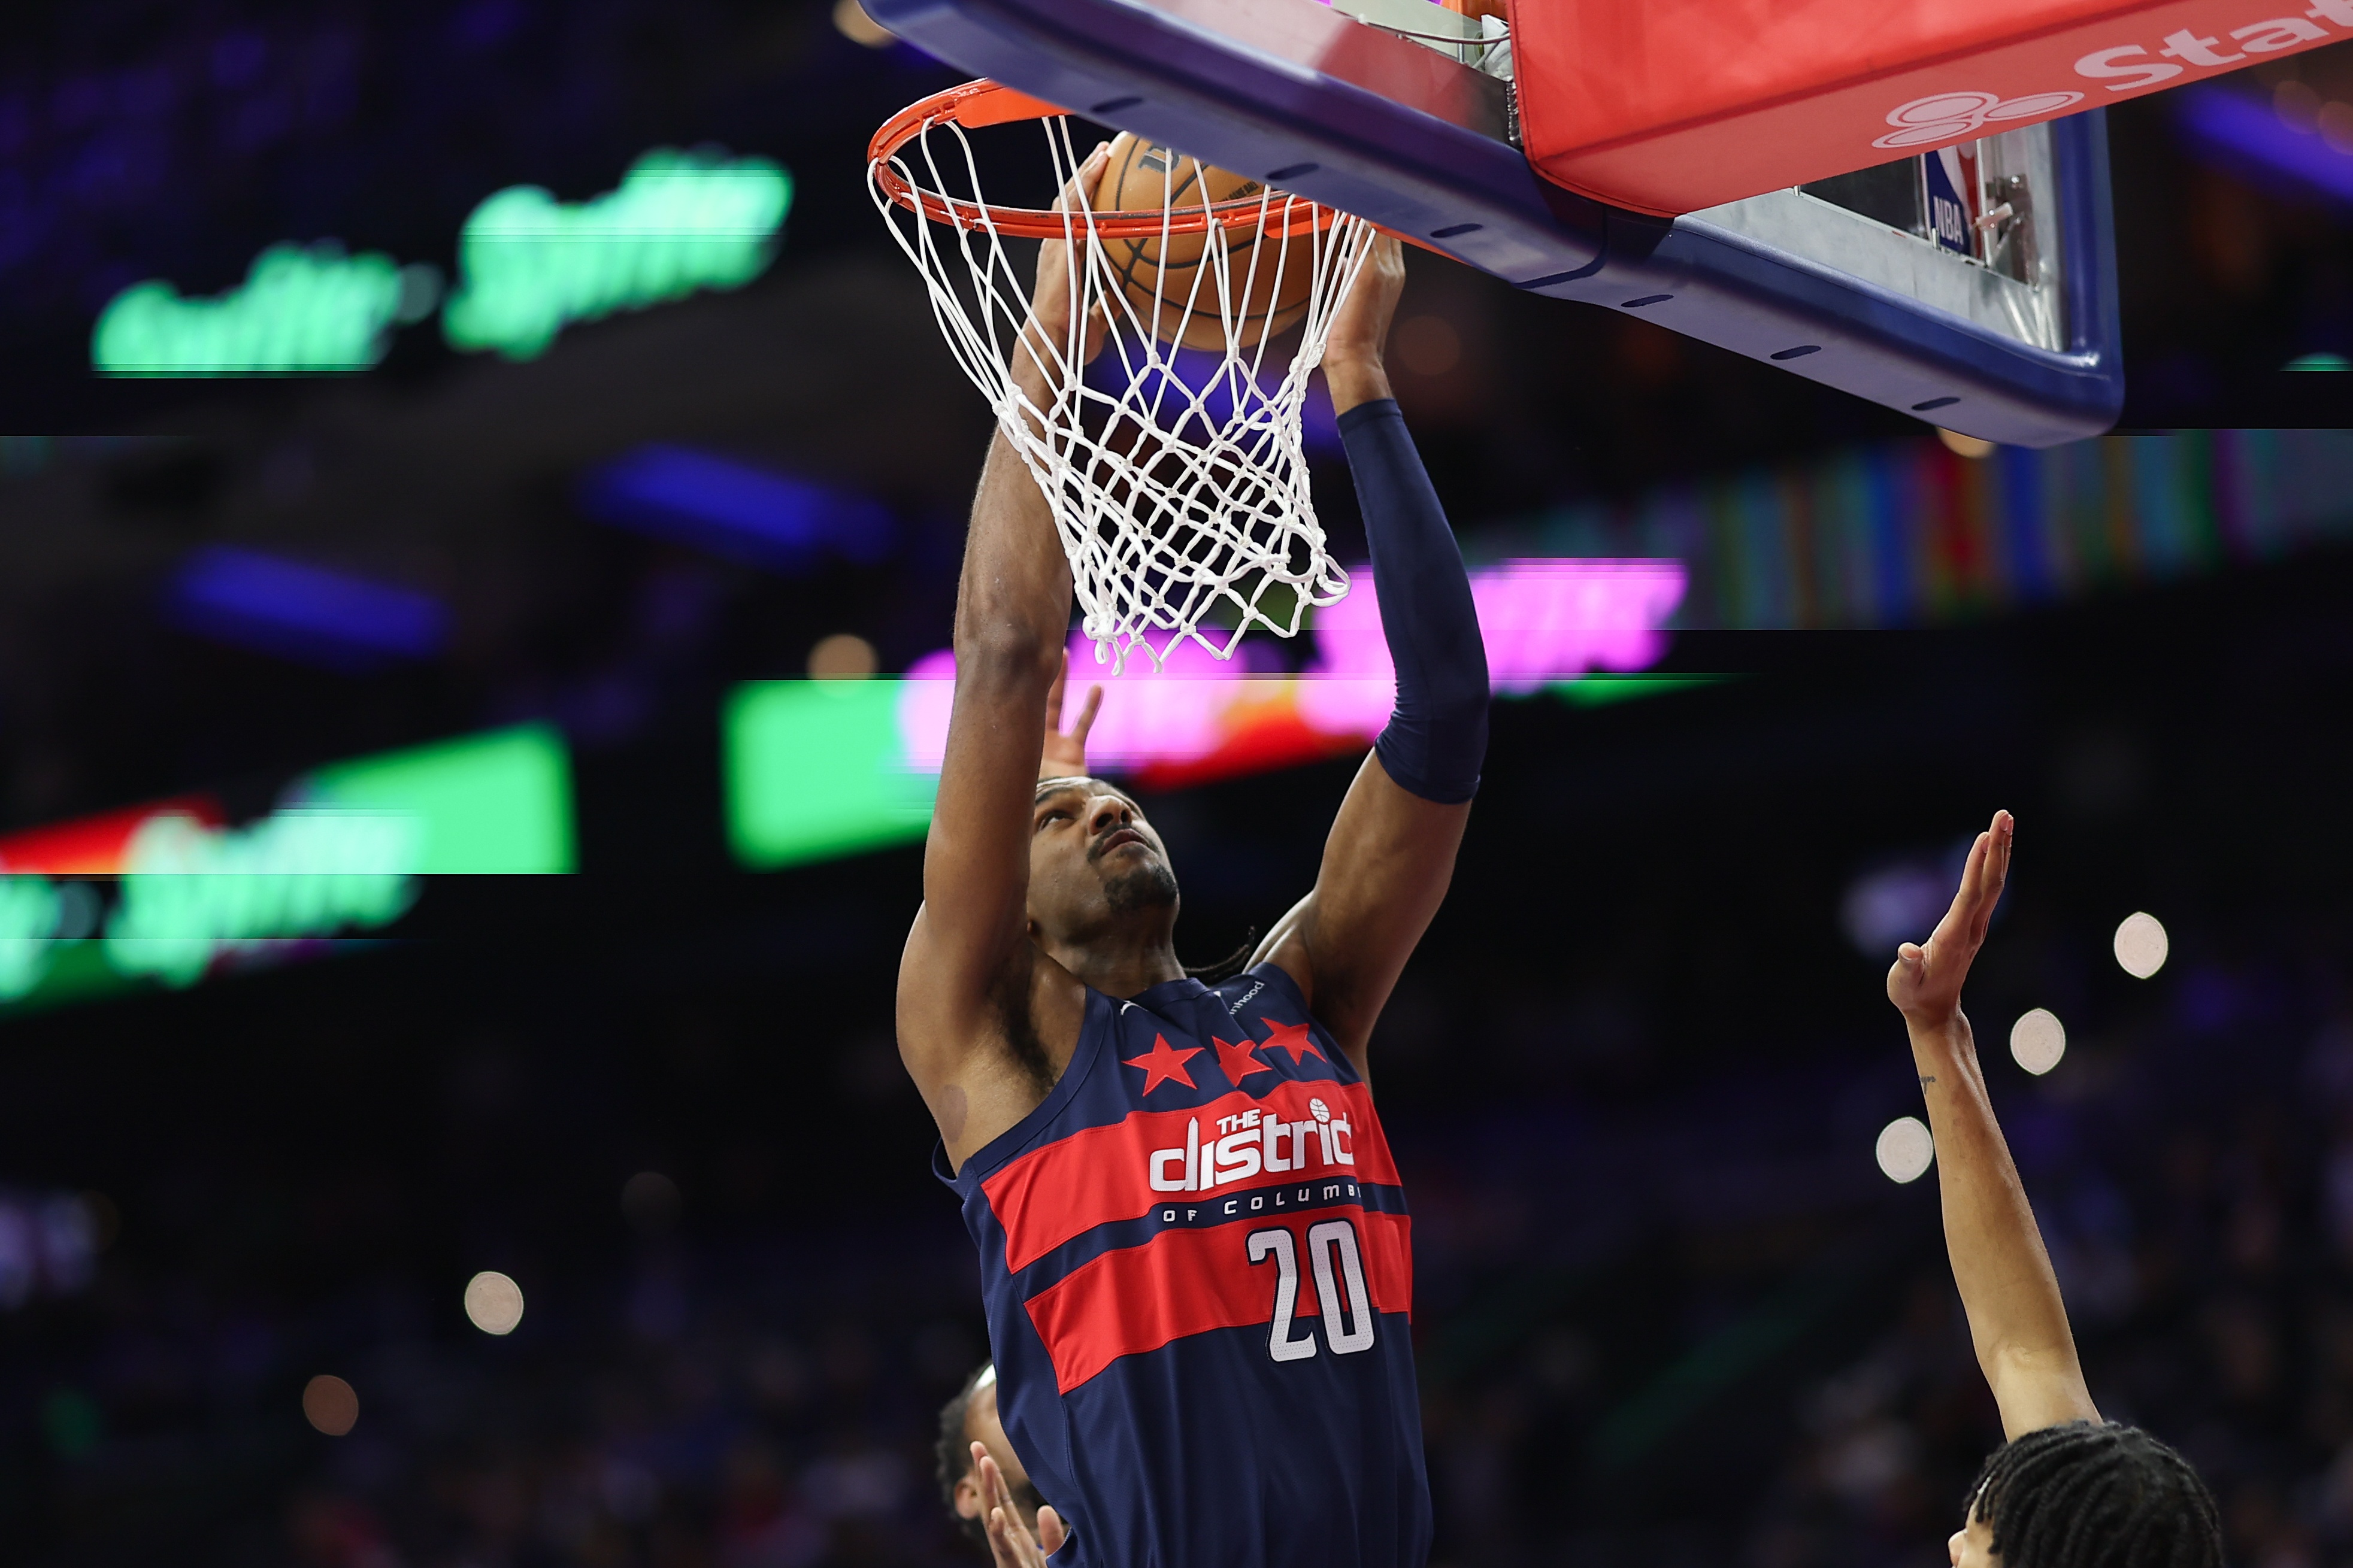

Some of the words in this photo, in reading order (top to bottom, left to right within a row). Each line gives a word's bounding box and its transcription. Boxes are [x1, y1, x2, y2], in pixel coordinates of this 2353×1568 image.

[2074, 0, 2353, 92] Stat
[1933, 195, 1964, 245] NBA
[1229, 981, 1265, 1015] inhood
[1149, 1098, 1355, 1191] distric
[1216, 1108, 1261, 1135] THE
[1163, 1209, 1198, 1222] OF
[1246, 1219, 1375, 1363] 20
